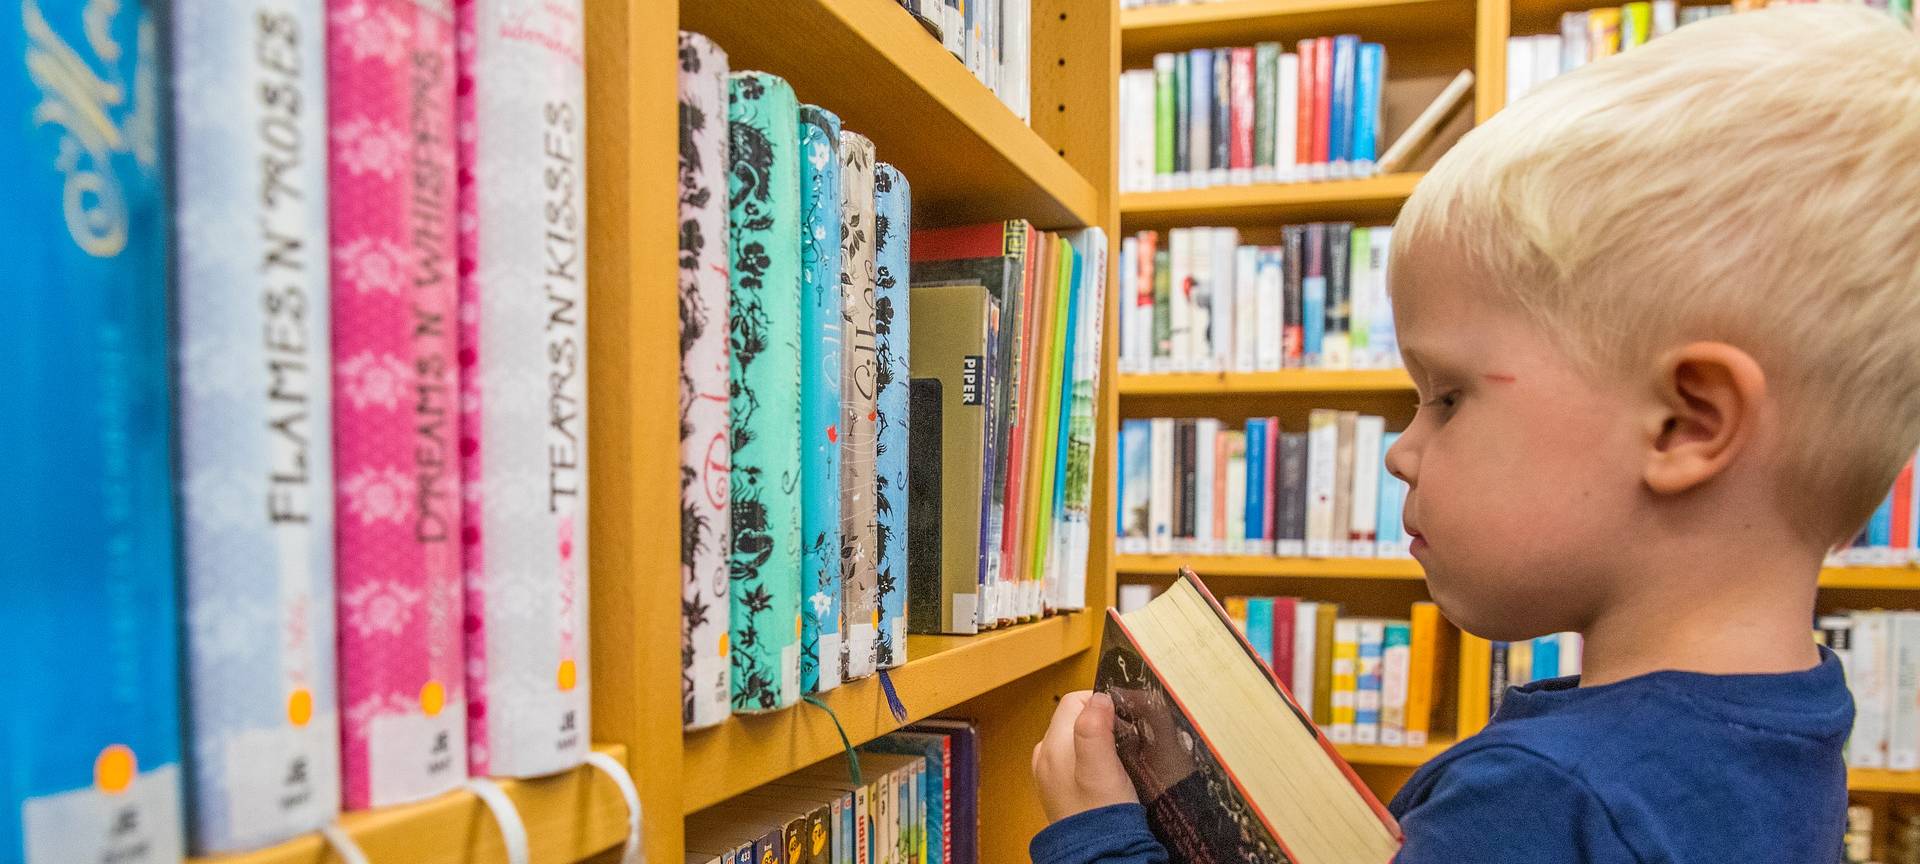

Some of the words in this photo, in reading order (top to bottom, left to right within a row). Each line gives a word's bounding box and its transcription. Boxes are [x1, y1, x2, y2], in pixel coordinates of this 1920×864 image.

[256, 11, 303, 208] ROSES
[408, 48, 445, 289] WHISPERS
[543, 101, 577, 282] KISSES
[262, 285, 310, 525] FLAMES
[854, 260, 877, 401] Silber
[963, 358, 976, 404] PIPER
[414, 352, 448, 544] DREAMS
[547, 336, 578, 513] TEARS
